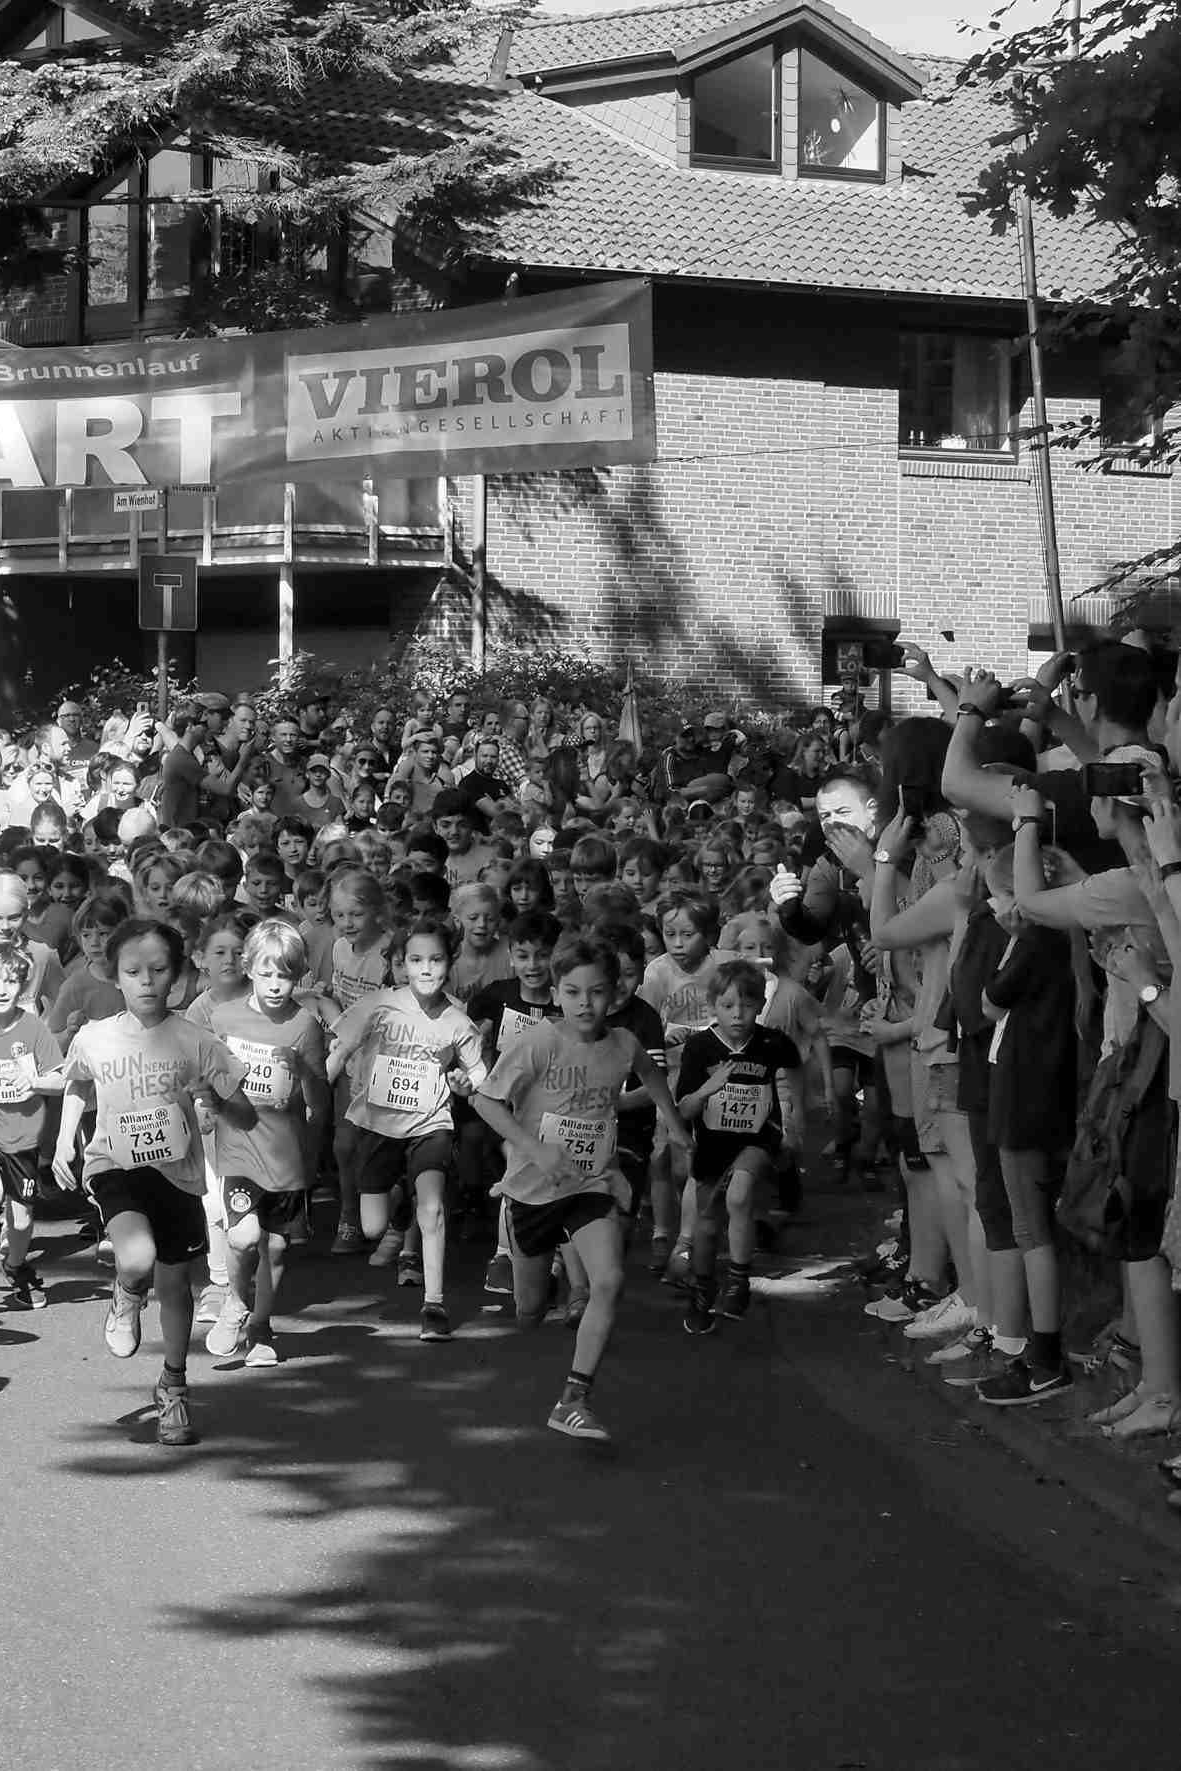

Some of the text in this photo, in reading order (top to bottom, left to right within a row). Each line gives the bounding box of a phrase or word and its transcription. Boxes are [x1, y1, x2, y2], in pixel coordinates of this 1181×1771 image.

[298, 345, 625, 421] VIEROL
[117, 496, 127, 507] Am
[242, 1080, 272, 1094] runs
[392, 1076, 420, 1093] 694
[387, 1089, 420, 1107] bruns
[720, 1101, 757, 1116] 1471
[120, 1112, 154, 1125] Allianz
[560, 1119, 594, 1131] Allianz
[721, 1114, 754, 1129] bruns
[130, 1129, 167, 1148] 734
[564, 1139, 596, 1155] 754
[131, 1146, 172, 1164] bruns
